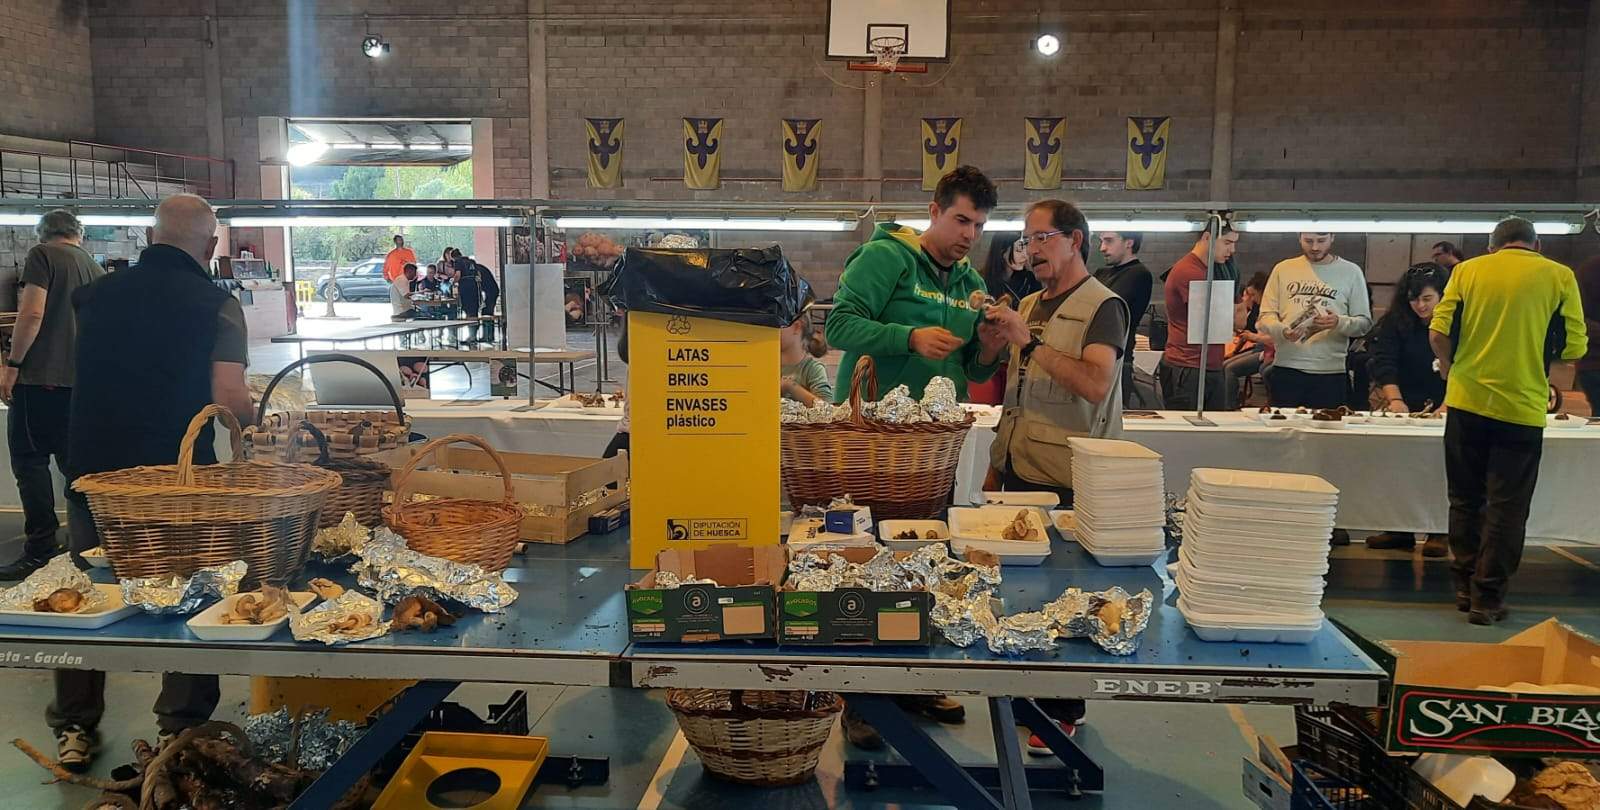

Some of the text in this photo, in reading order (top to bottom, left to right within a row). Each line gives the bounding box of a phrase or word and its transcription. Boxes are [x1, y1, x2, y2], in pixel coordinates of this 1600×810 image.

[668, 348, 710, 362] LATAS
[668, 373, 709, 387] BRIKS
[666, 398, 728, 412] ENVASES
[666, 414, 716, 430] plástico
[693, 521, 741, 529] DIPUTACIÓN
[693, 529, 741, 537] DE HUESCA
[34, 652, 83, 665] Garden
[1409, 699, 1508, 738] SAN
